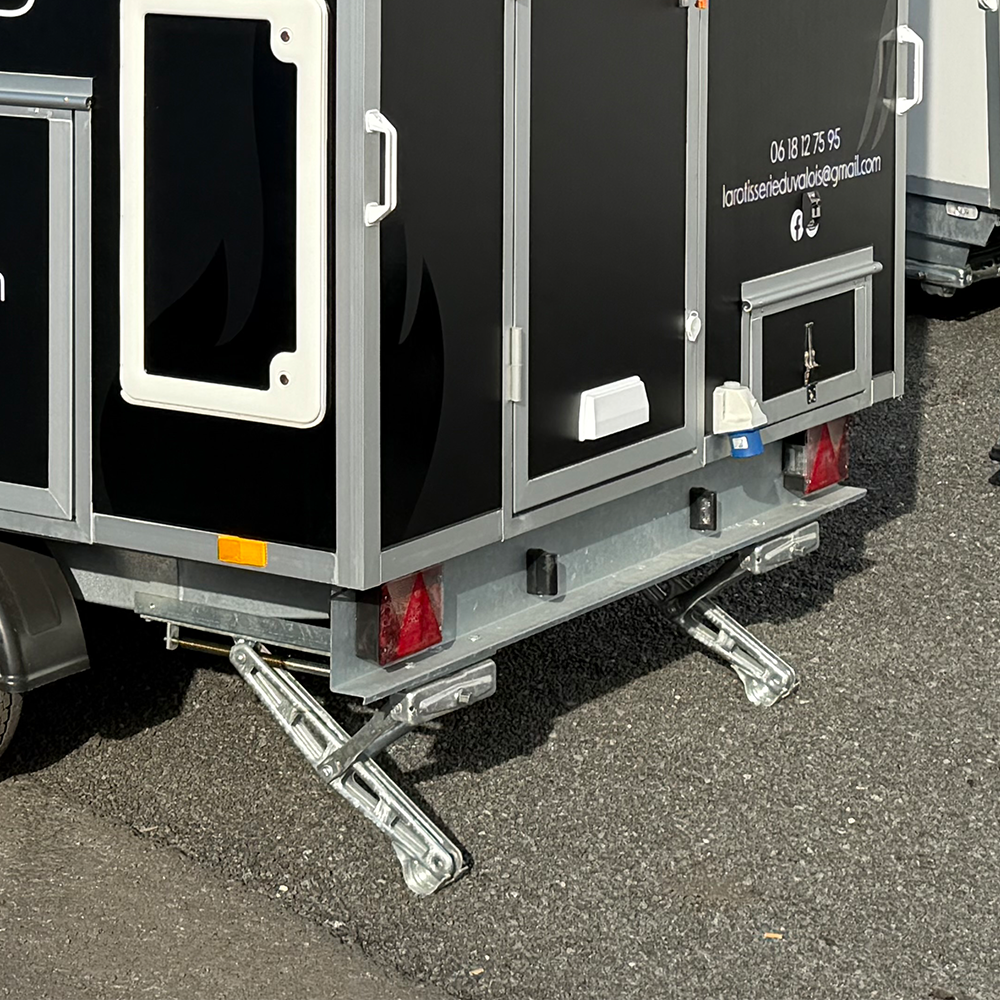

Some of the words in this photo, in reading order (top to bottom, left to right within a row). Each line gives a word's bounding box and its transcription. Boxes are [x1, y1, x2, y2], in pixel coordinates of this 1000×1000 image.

[770, 139, 786, 163] 06
[787, 136, 799, 160] 18
[800, 133, 811, 157] 12
[812, 130, 825, 154] 75
[827, 127, 841, 151] 95
[722, 154, 882, 208] larotisserieduvalois@gmail.com
